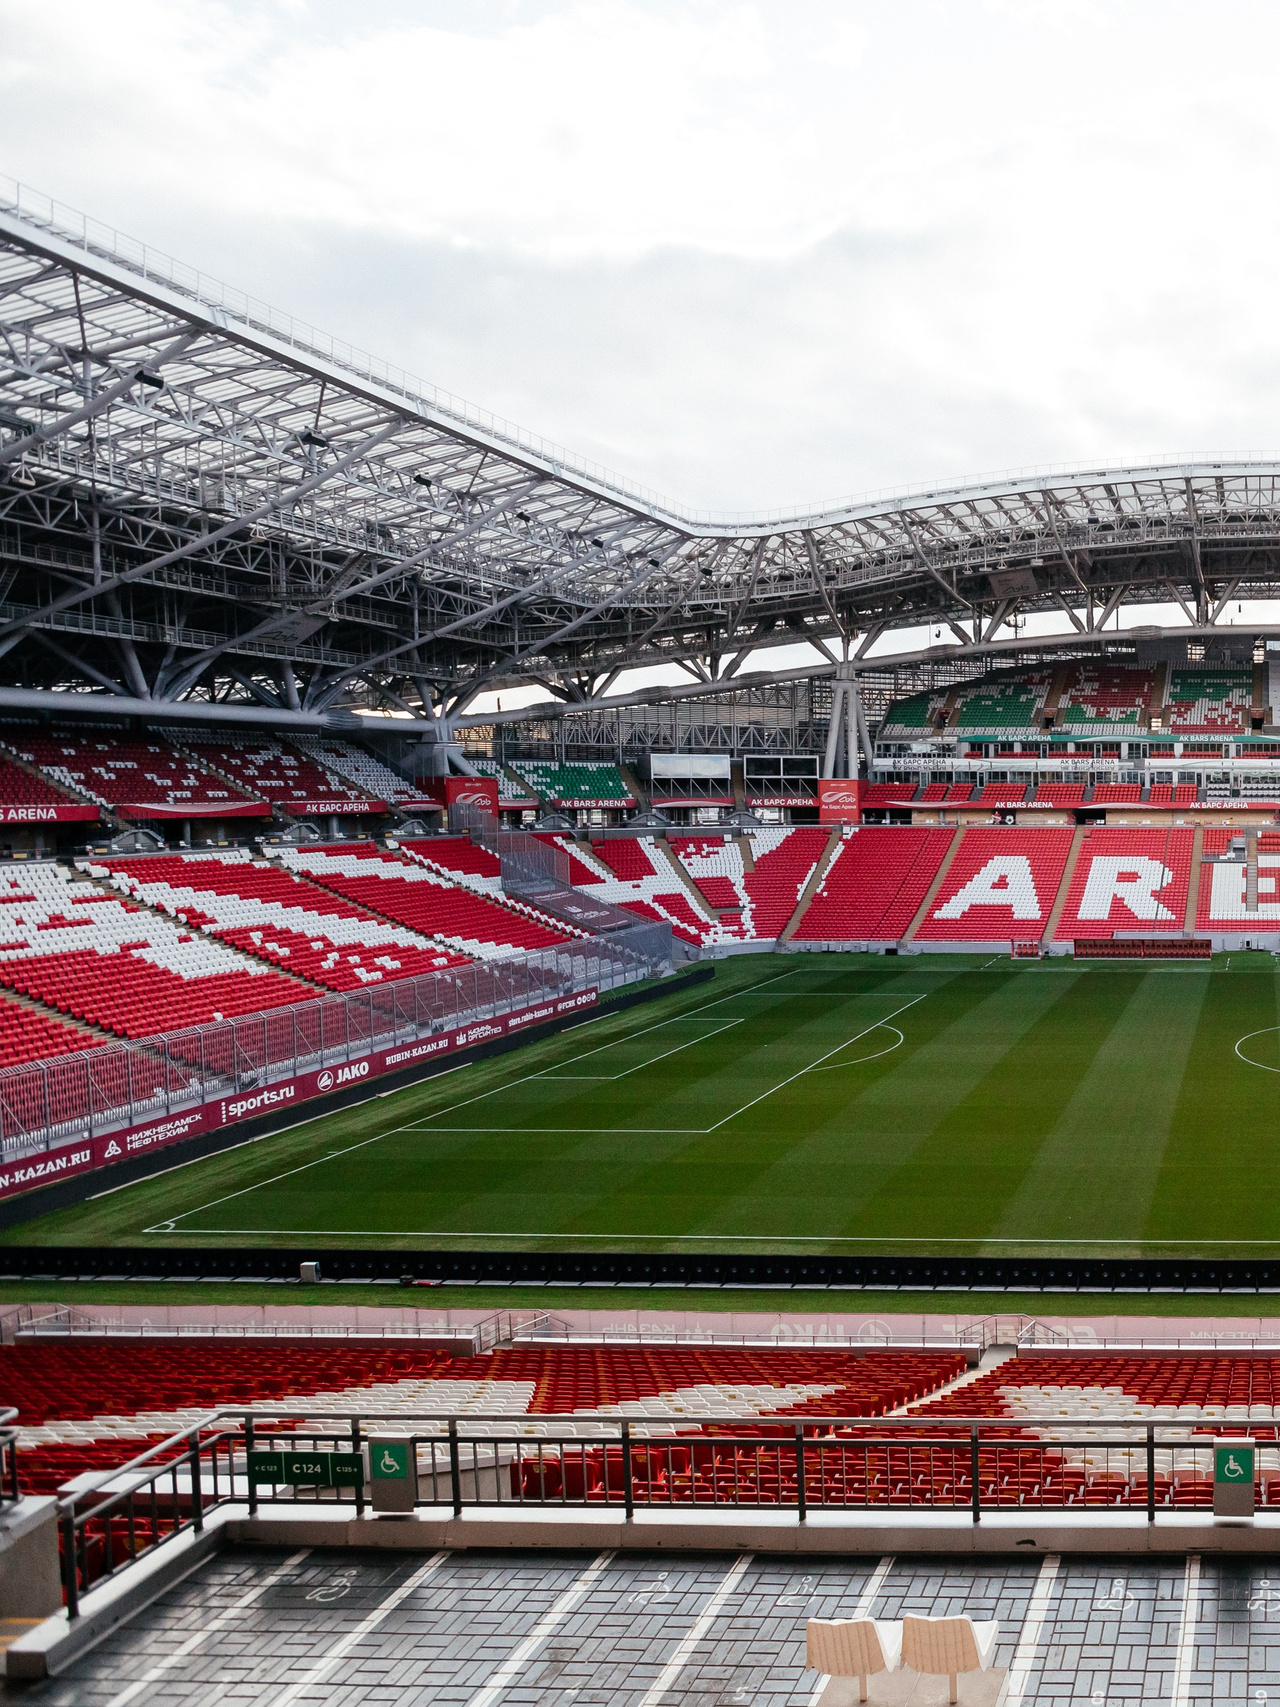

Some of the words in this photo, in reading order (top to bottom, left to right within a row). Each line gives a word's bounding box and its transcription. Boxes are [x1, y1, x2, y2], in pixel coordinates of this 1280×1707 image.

[306, 804, 318, 813] АК
[319, 804, 342, 812] БАРС
[343, 803, 370, 812] АРЕНА
[560, 800, 572, 808] AK
[574, 800, 597, 808] BARS
[597, 800, 627, 808] ARENA
[7, 808, 58, 820] ARENA
[385, 1038, 449, 1066] RUBIN-KAZAN.RU
[336, 1061, 370, 1084] JAKO
[228, 1085, 295, 1116] sports.ru
[126, 1113, 202, 1143] НИЖНЕКАМСК
[127, 1125, 189, 1151] НЕФТЕХИМ
[292, 1464, 301, 1473] C
[302, 1464, 322, 1473] 124
[1255, 1689, 1268, 1704] 9
